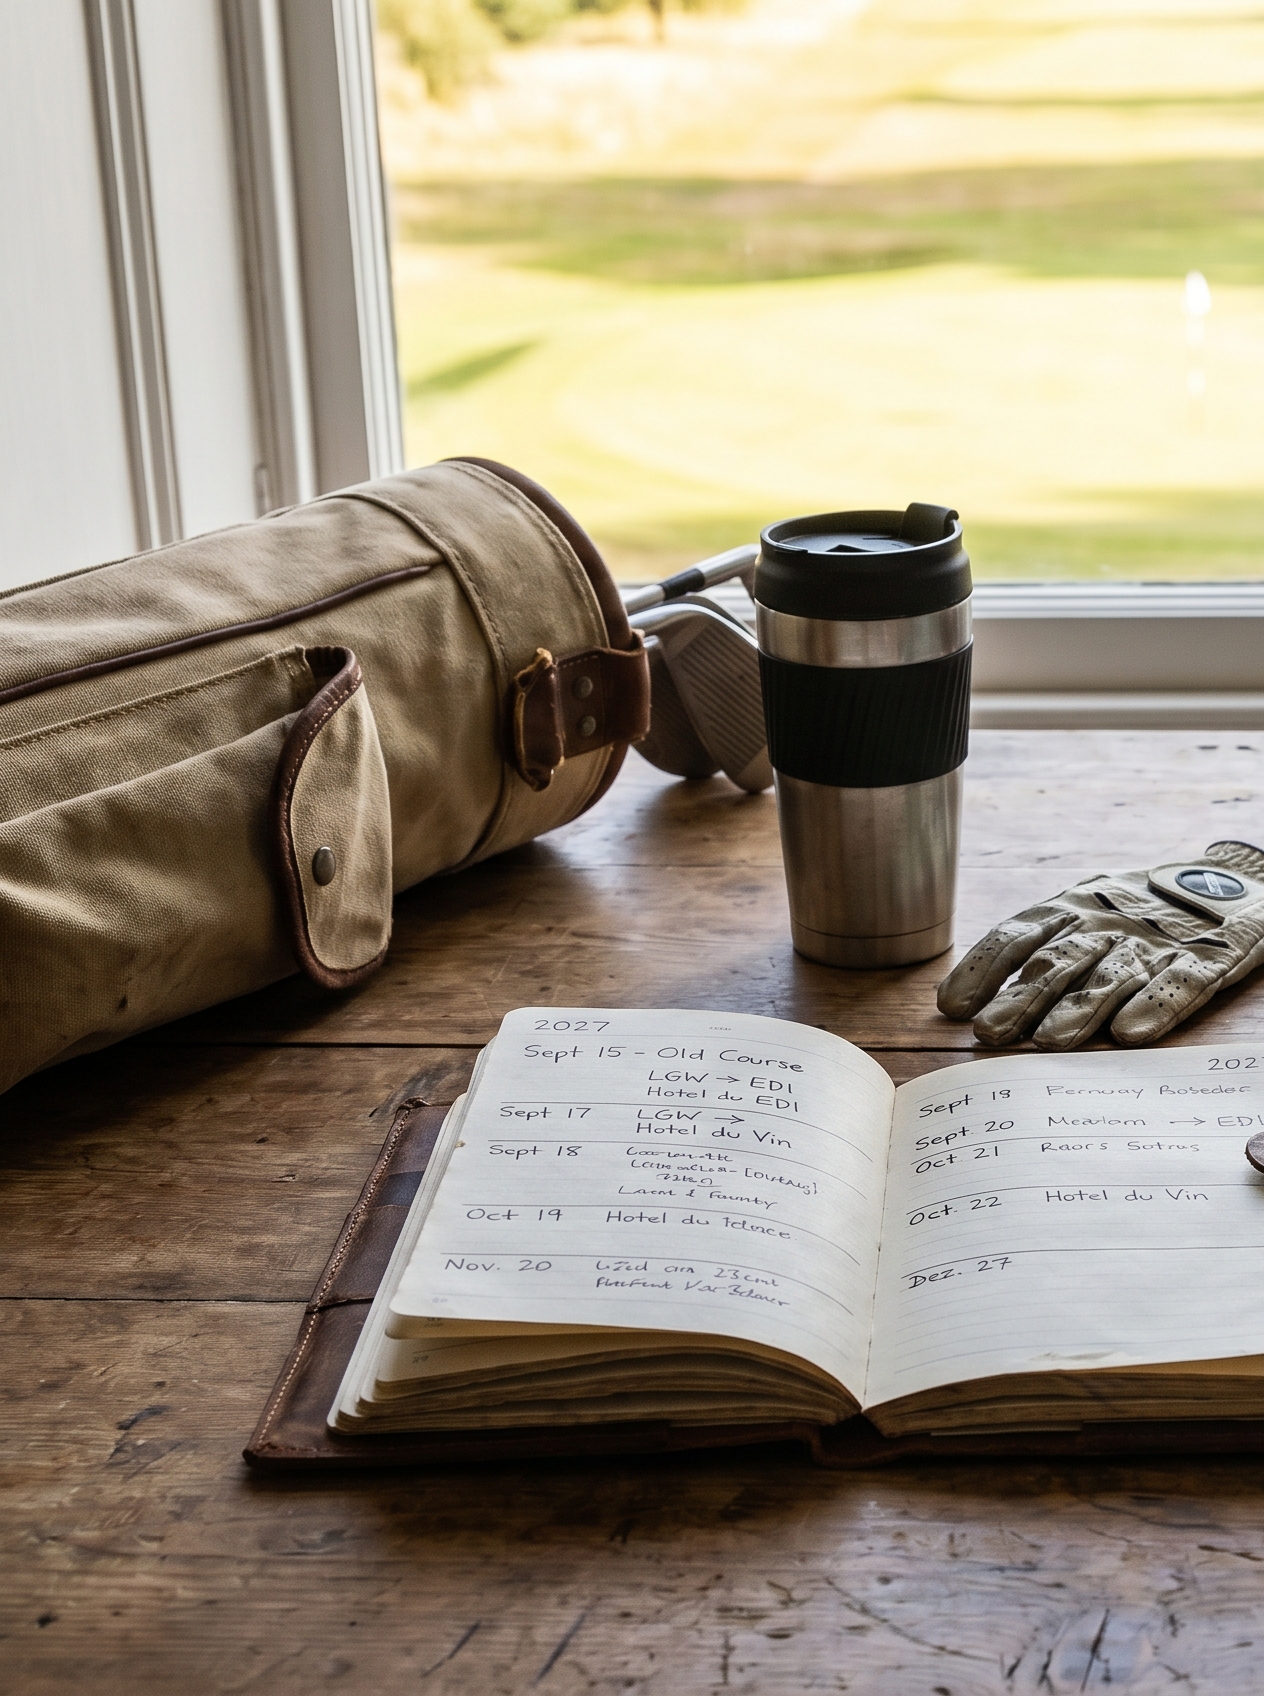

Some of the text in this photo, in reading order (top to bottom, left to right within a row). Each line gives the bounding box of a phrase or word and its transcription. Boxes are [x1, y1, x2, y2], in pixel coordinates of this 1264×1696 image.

[534, 1019, 611, 1032] 2027
[523, 1044, 584, 1063] Sept
[598, 1046, 627, 1058] 15
[657, 1046, 705, 1061] Old
[719, 1049, 804, 1073] Course
[648, 1070, 793, 1094] LGW EDI
[647, 1086, 799, 1112] Hotel du EDI
[918, 1093, 974, 1119] Sept
[500, 1106, 702, 1121] Sept 17 LGW
[984, 1120, 1014, 1133] 20
[1217, 1114, 1264, 1127] EDI
[635, 1122, 793, 1149] Hotel du Vin
[557, 1145, 583, 1157] 18
[972, 1145, 998, 1160] 21
[969, 1196, 1002, 1211] 22
[1045, 1189, 1108, 1203] Hotel
[1124, 1189, 1153, 1202] du
[1165, 1188, 1209, 1202] Vin
[465, 1207, 520, 1221] Oct
[537, 1208, 564, 1222] 19
[605, 1210, 667, 1224] Hotel
[681, 1214, 710, 1225] du
[444, 1258, 501, 1272] Nov.
[518, 1259, 552, 1272] 20
[977, 1256, 1013, 1273] 27
